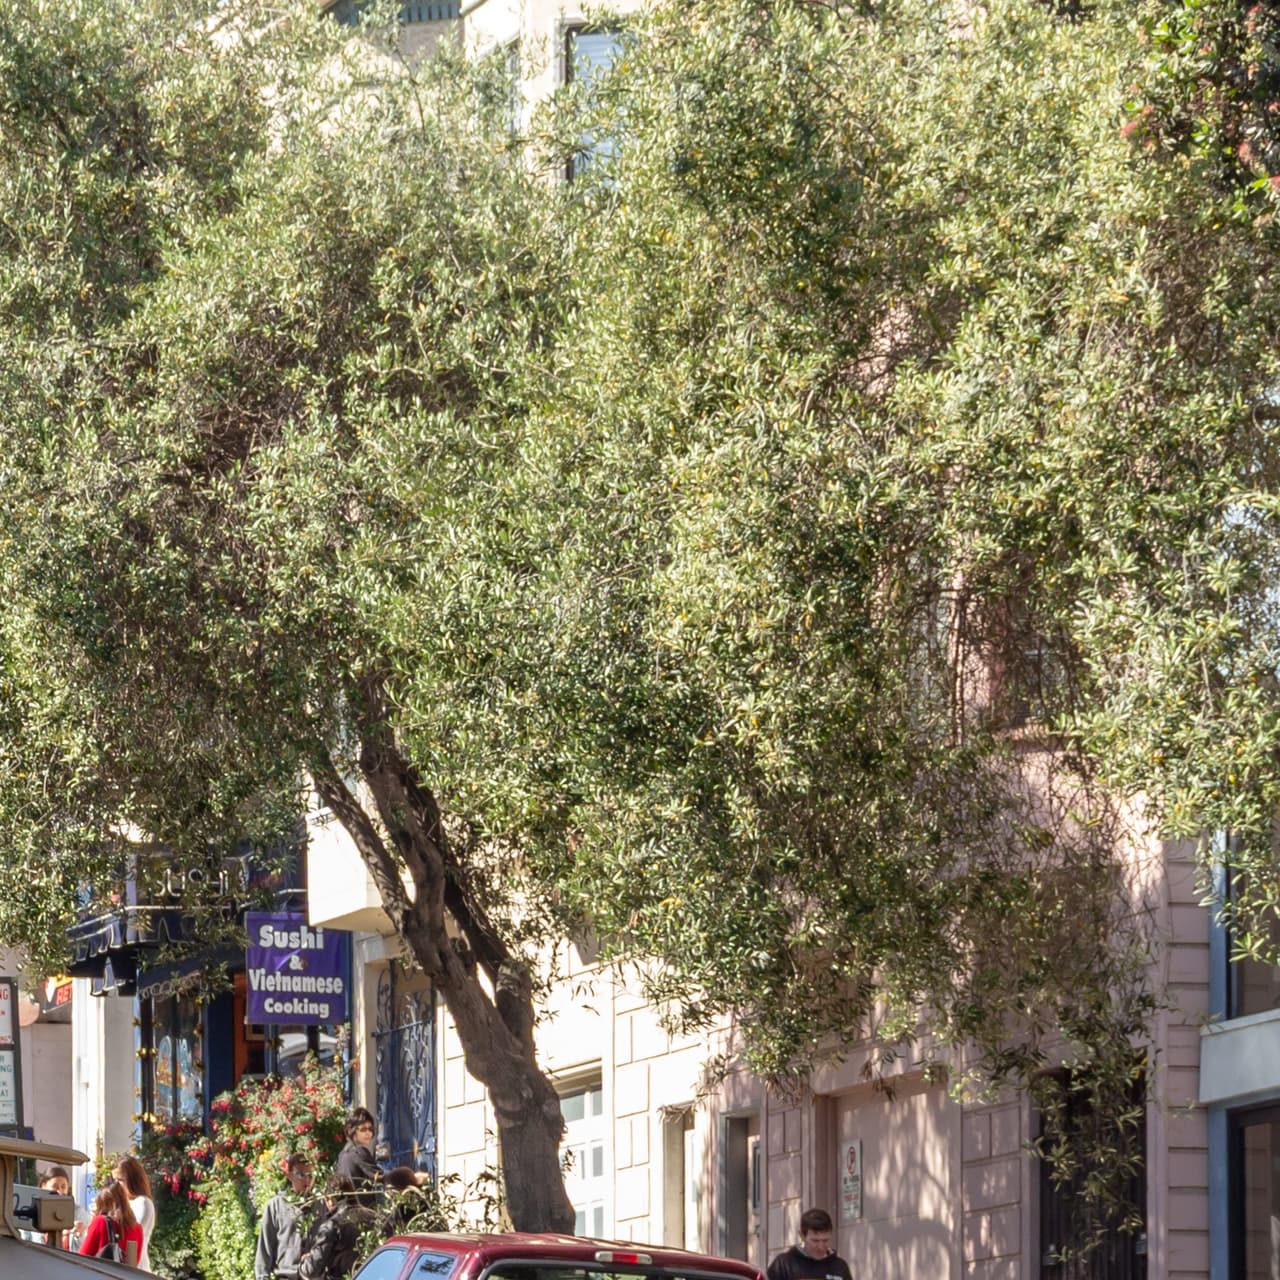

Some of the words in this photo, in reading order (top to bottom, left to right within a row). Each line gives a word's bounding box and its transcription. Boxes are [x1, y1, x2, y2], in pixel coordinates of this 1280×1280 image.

[259, 925, 324, 950] Sushi
[289, 954, 303, 970] &
[248, 967, 343, 994] Vietnamese
[264, 997, 330, 1018] Cooking
